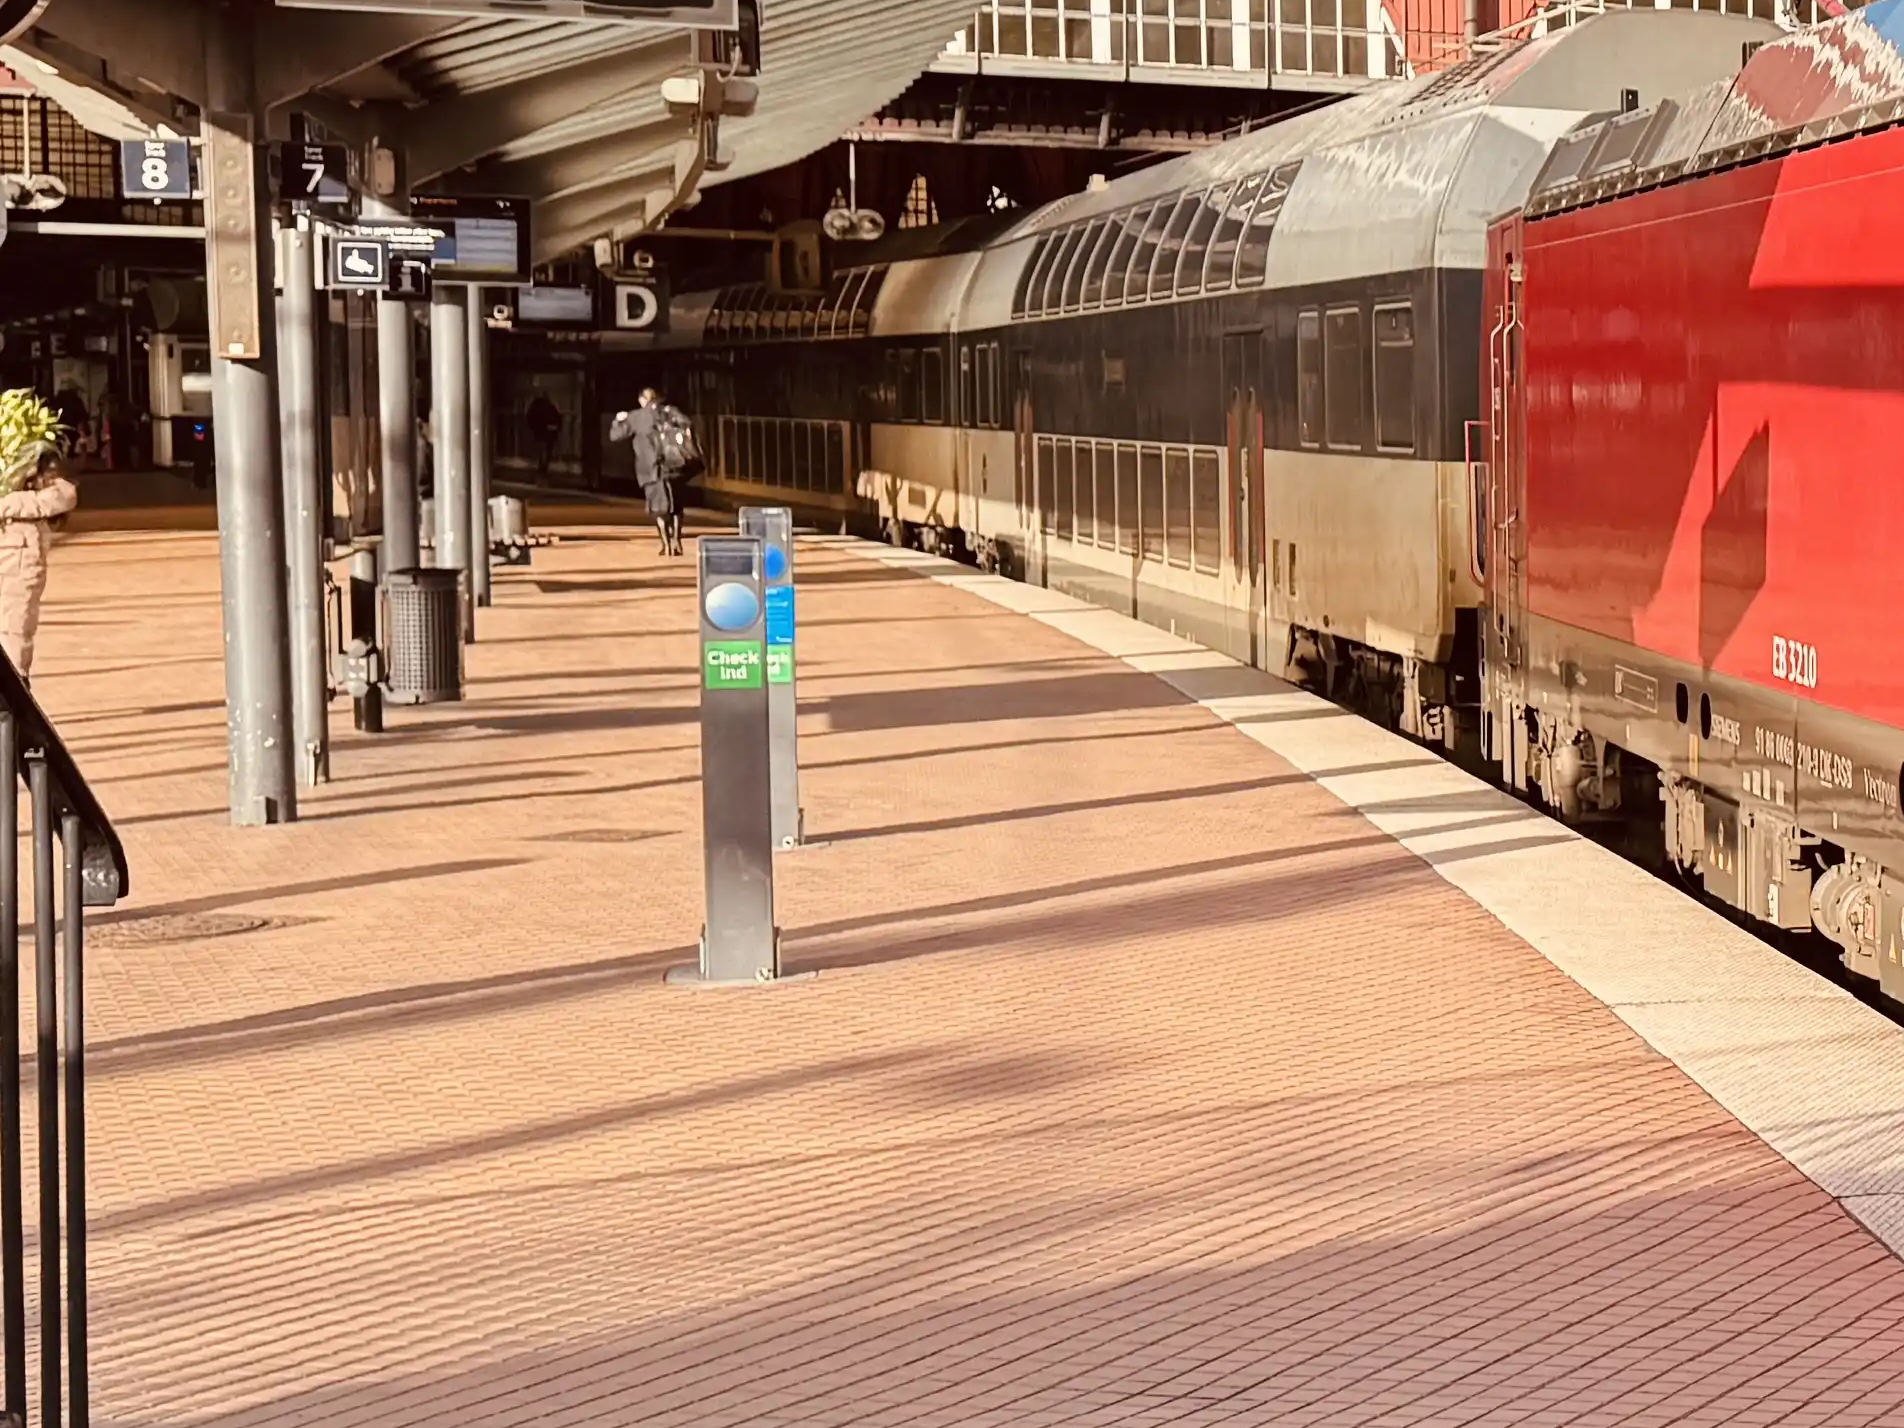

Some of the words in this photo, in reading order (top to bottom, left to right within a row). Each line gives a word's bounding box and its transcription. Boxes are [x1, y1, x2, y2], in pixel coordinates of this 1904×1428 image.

[141, 158, 168, 190] 8
[302, 163, 324, 192] 7
[615, 285, 658, 328] D
[707, 650, 760, 666] Check
[1773, 635, 1787, 679] EB
[1788, 639, 1817, 689] 3210
[1755, 726, 1764, 755] 91
